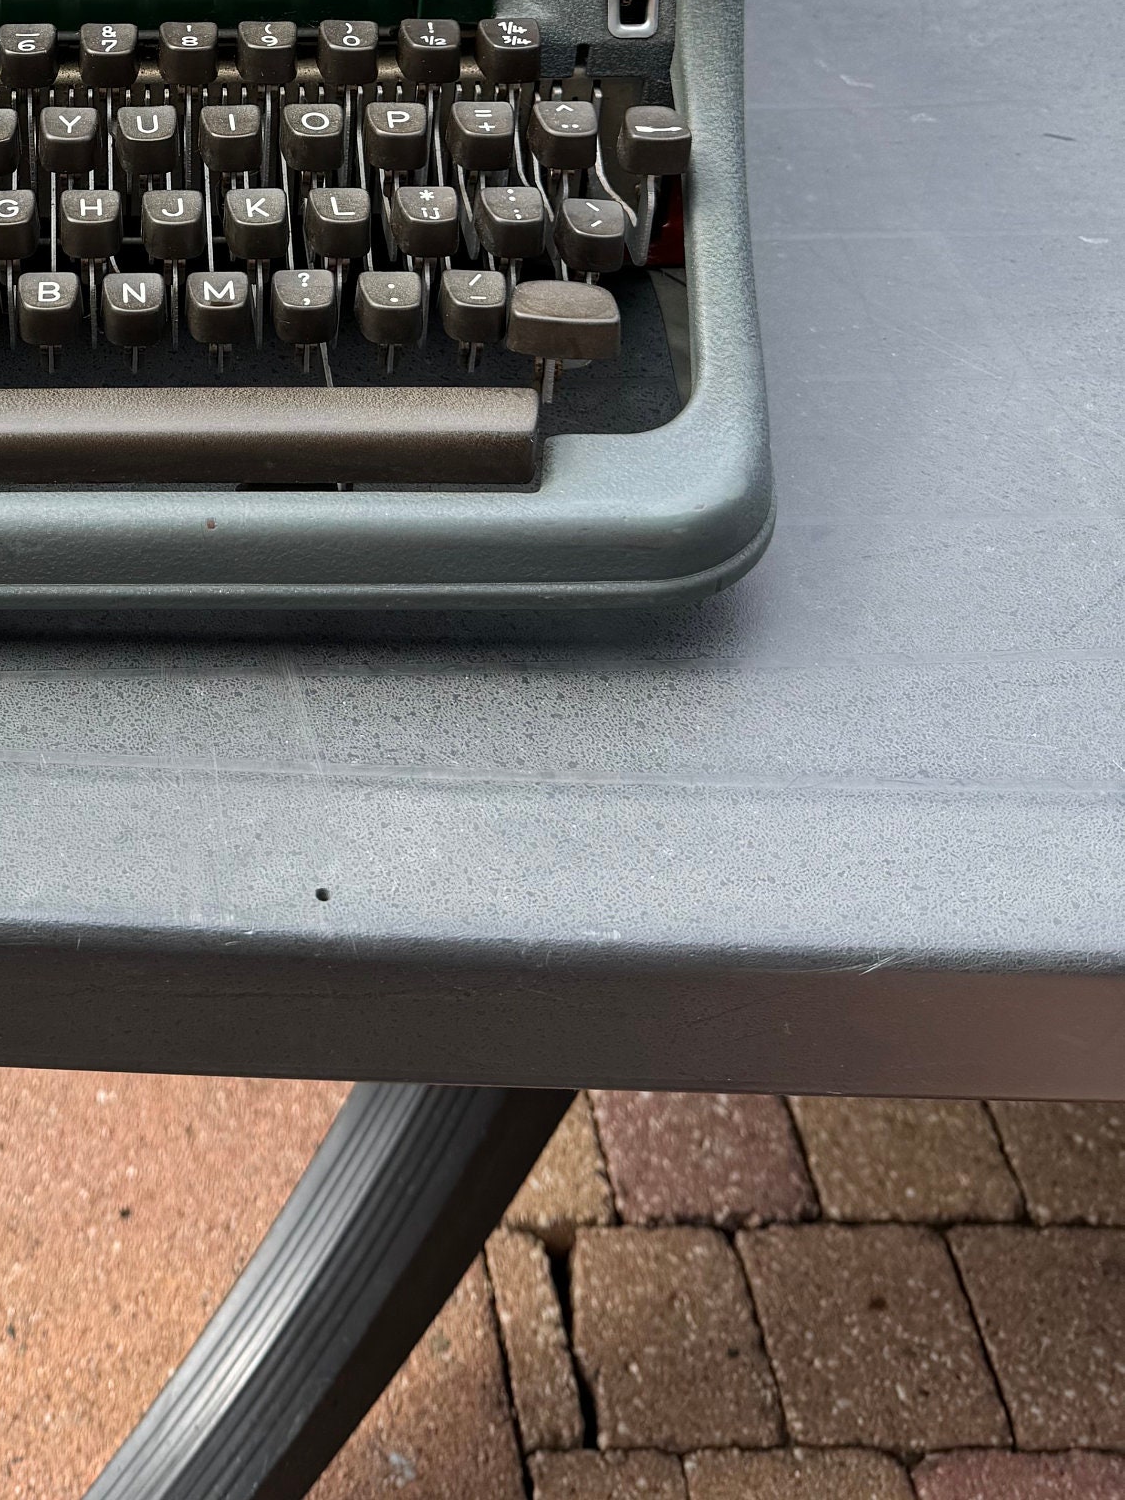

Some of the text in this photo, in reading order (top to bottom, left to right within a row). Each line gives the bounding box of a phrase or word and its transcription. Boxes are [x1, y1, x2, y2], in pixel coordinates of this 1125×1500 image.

[101, 25, 117, 38] &
[261, 35, 279, 47] 9
[342, 35, 361, 47] 0
[17, 39, 36, 52] 6
[101, 39, 118, 53] 7
[181, 36, 199, 47] 8
[58, 115, 82, 134] Y
[136, 114, 159, 134] U
[228, 113, 236, 131] I
[301, 112, 330, 131] O
[386, 110, 411, 129] P
[79, 198, 103, 217] H
[161, 197, 184, 217] J
[245, 197, 270, 218] K
[330, 196, 356, 216] L
[297, 272, 311, 288] ?
[37, 281, 61, 302] B
[122, 282, 146, 304] N
[203, 280, 235, 301] M
